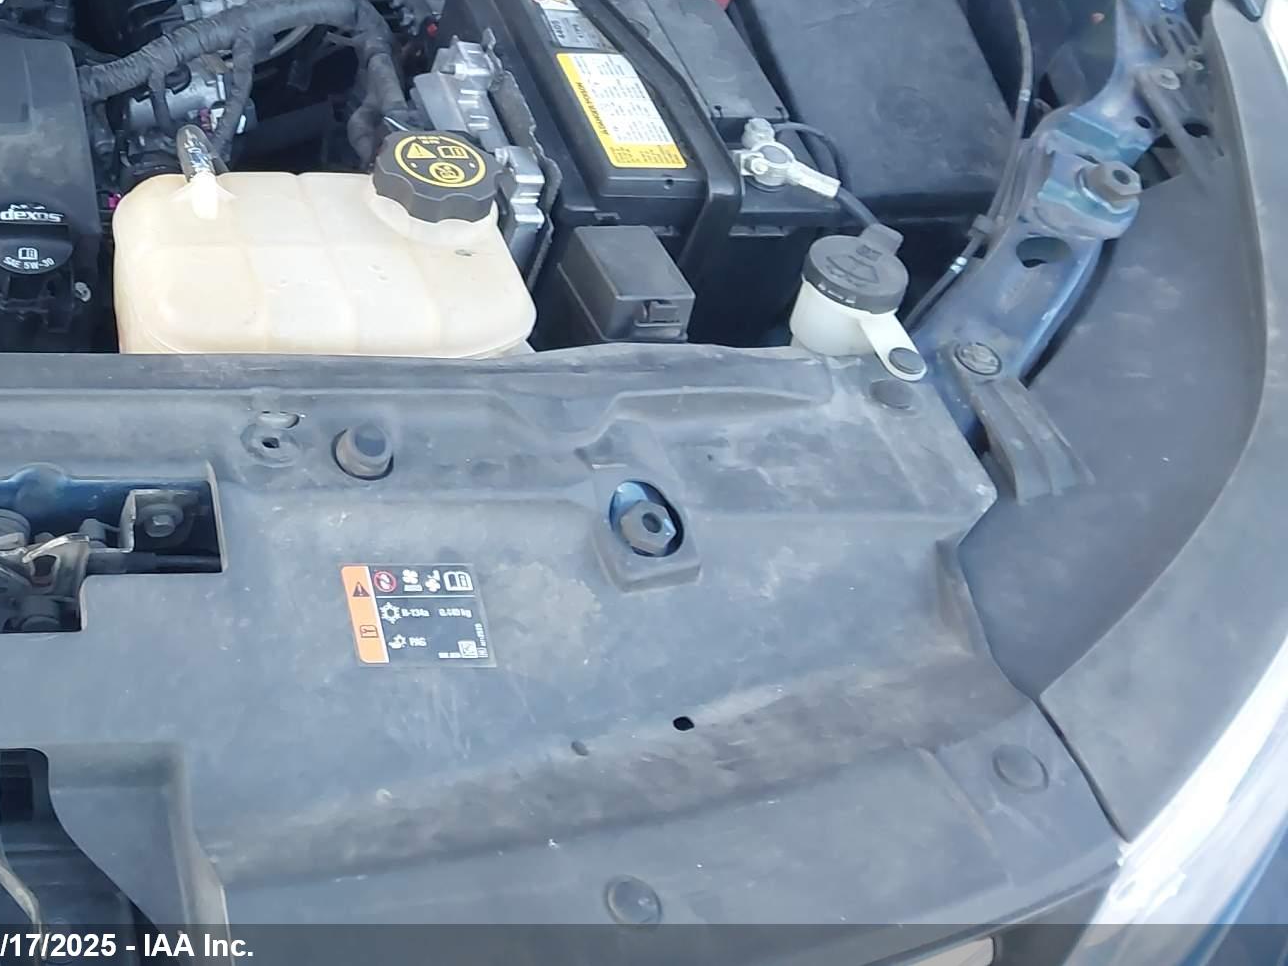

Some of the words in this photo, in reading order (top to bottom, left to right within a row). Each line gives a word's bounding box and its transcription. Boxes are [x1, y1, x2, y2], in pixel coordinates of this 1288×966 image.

[0, 208, 64, 223] dexos
[3, 256, 22, 269] SAE
[23, 257, 55, 270] 5W-30
